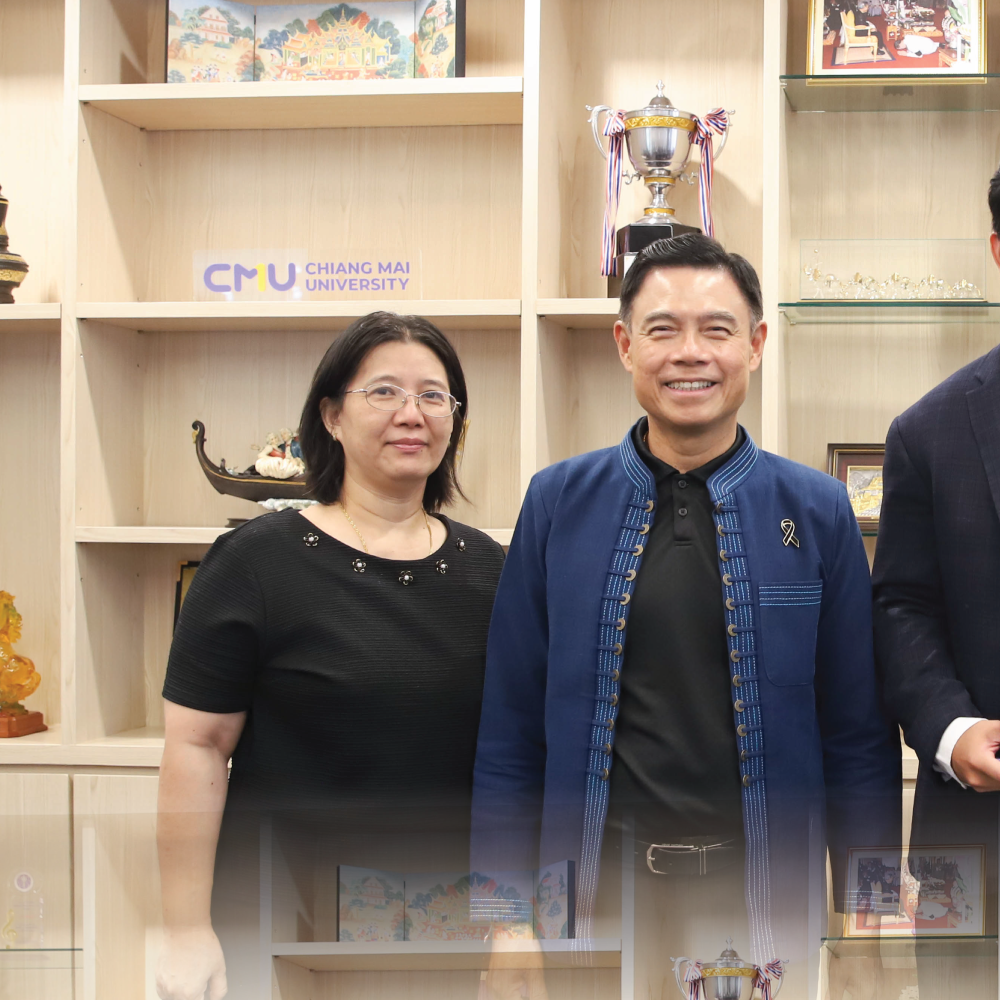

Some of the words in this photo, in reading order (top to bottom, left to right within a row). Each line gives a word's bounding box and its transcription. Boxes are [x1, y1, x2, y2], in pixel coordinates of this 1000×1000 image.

[305, 262, 372, 275] CHIANG
[378, 262, 410, 274] MAI
[204, 262, 296, 292] CMU
[305, 278, 410, 291] UNIVERSITY
